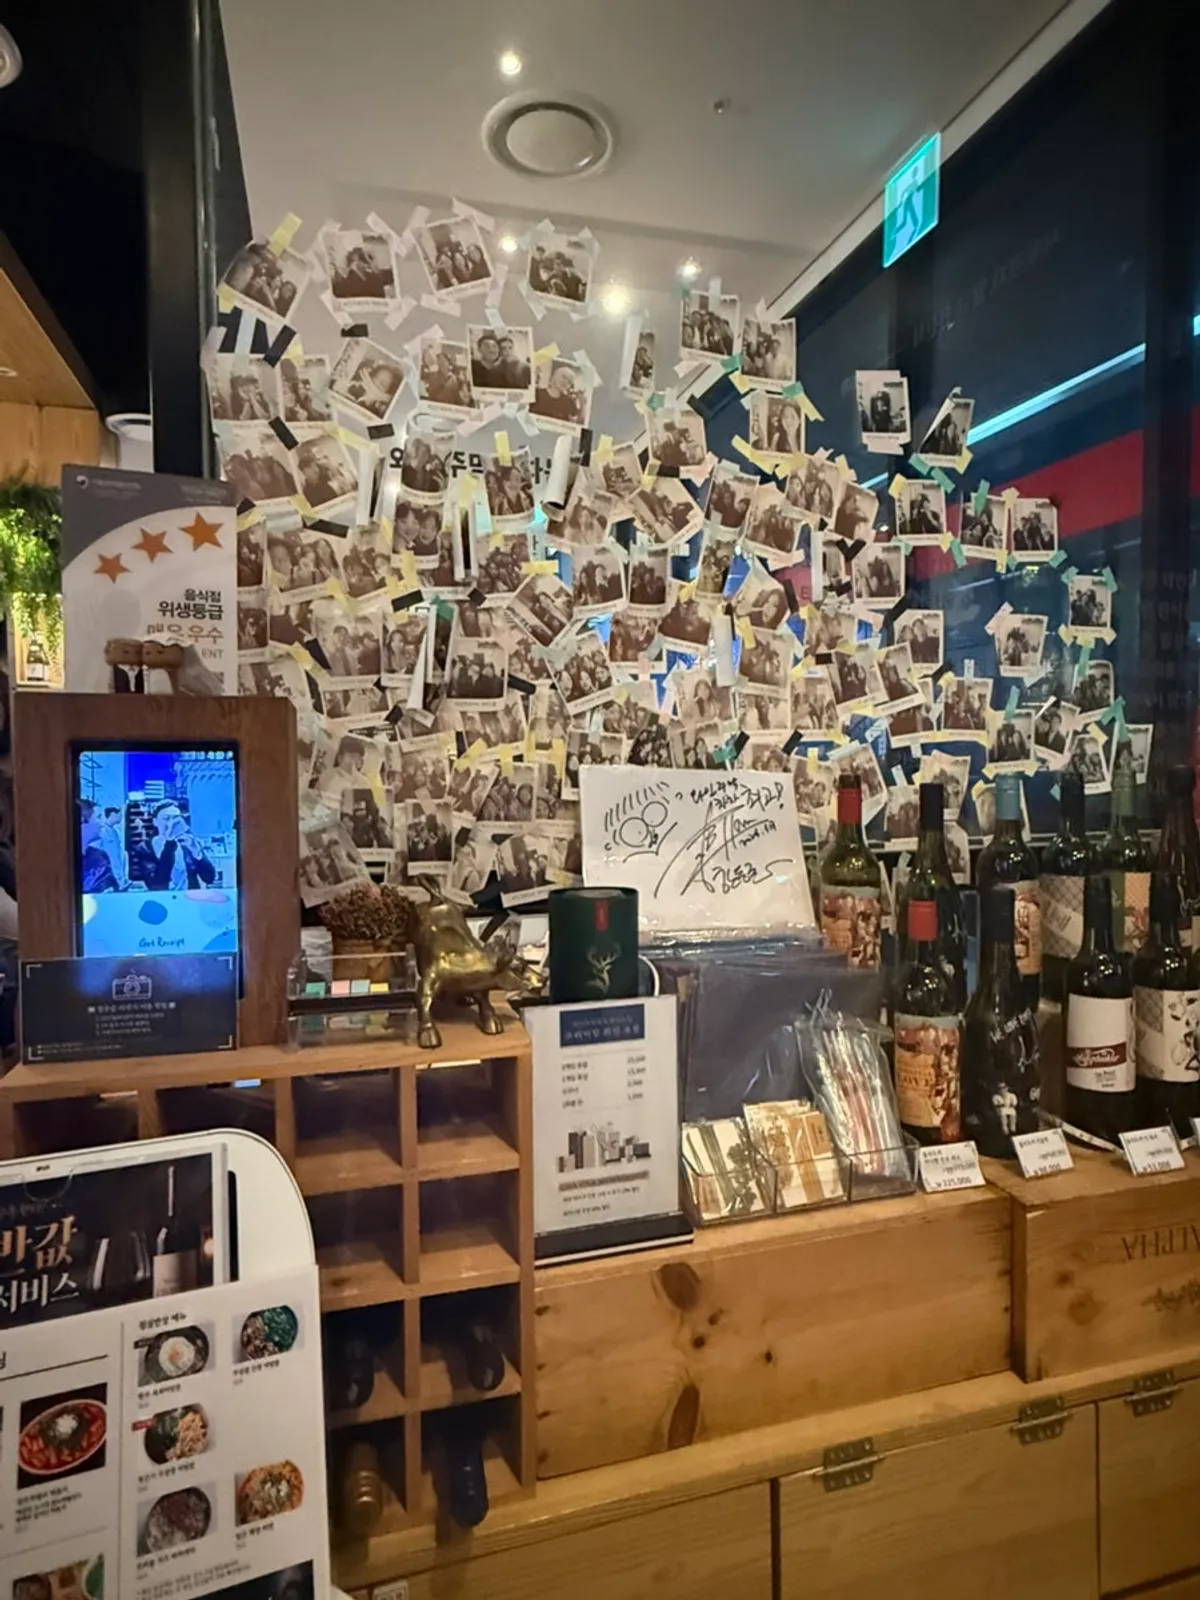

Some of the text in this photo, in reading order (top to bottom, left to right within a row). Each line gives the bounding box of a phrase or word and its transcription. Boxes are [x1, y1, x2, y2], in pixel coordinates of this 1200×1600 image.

[184, 588, 222, 603] 음식점
[158, 600, 224, 620] 위생등급
[188, 625, 224, 644] 우수
